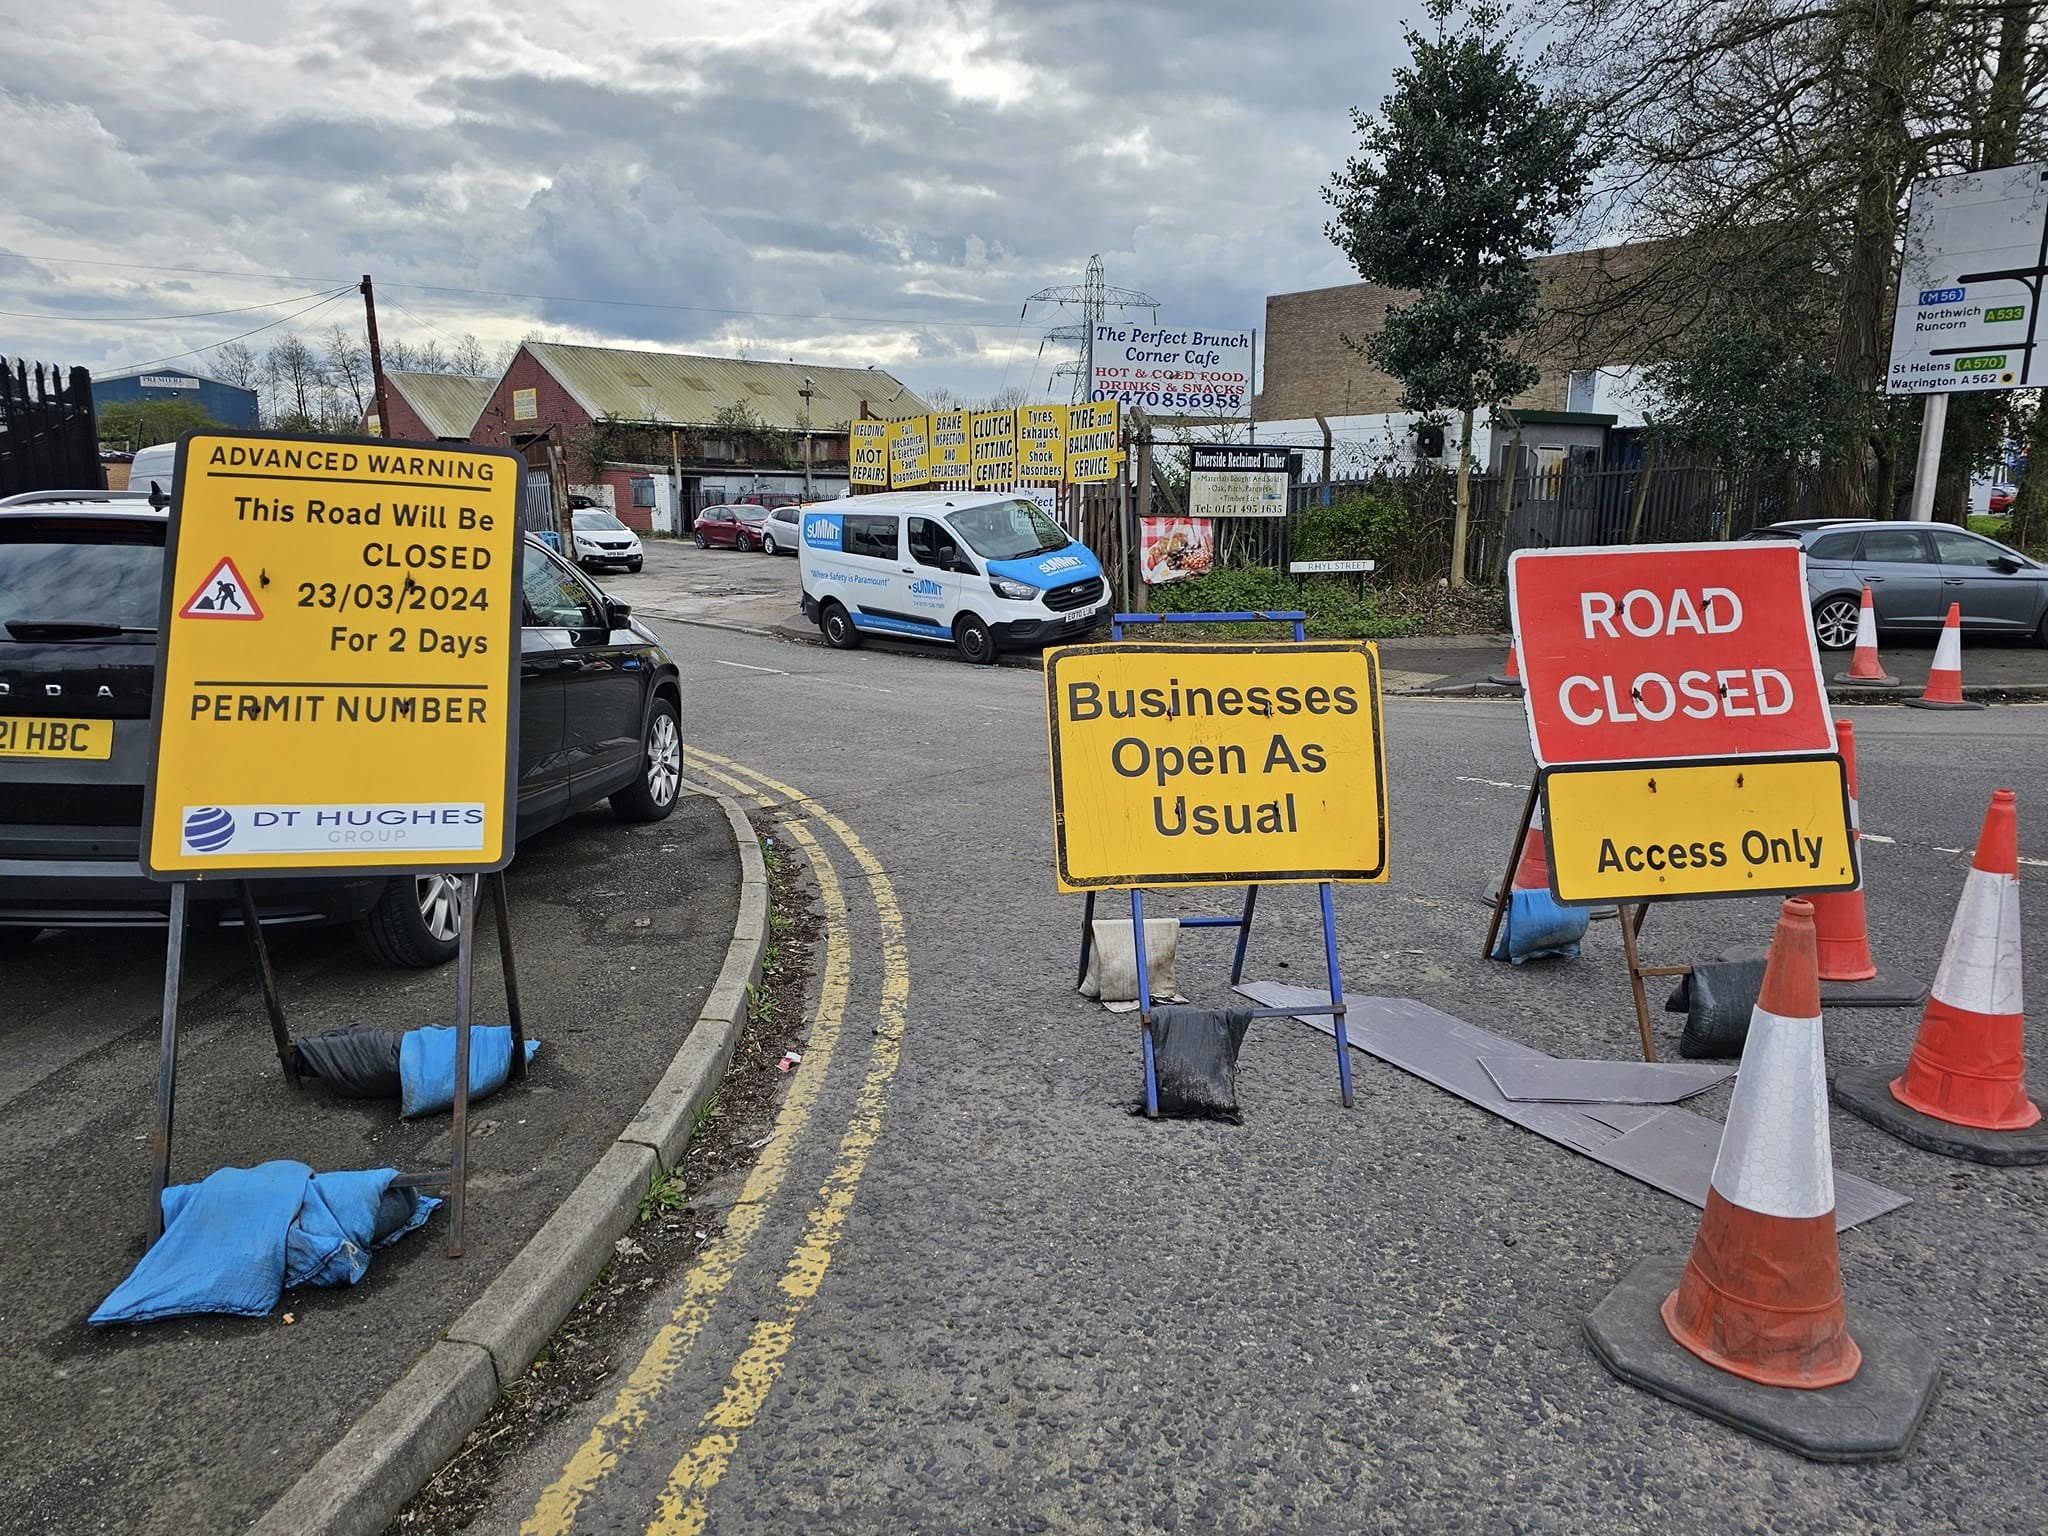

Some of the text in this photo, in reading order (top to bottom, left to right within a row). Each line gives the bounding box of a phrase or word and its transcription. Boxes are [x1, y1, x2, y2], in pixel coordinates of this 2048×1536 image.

[1917, 306, 1981, 320] Northwich
[1915, 321, 1967, 332] Runcorn
[1096, 326, 1249, 348] The Perfect Brunch
[1125, 347, 1220, 368] Corner Cafe
[1095, 367, 1130, 378] HOT
[1135, 368, 1147, 379] &
[1151, 370, 1195, 380] COLD
[1892, 364, 1906, 374] St
[1910, 362, 1951, 373] Helens
[1099, 380, 1245, 395] DRINKS & SNACKS
[1891, 376, 1957, 389] Warrington
[936, 415, 962, 431] BRAKE
[1028, 410, 1056, 425] Tyres,
[1069, 407, 1113, 431] TYRE and
[853, 424, 885, 437] WELDING
[901, 423, 913, 436] Full
[973, 415, 1012, 439] CLUTCH
[1021, 426, 1062, 440] Exhaust,
[891, 432, 925, 449] Mechanical
[933, 431, 966, 447] INSPECTION
[1035, 440, 1047, 449] and
[1069, 431, 1115, 454] BALANCING
[855, 448, 882, 464] MOT
[898, 444, 927, 460] Electrical
[943, 448, 956, 461] AND
[975, 439, 1013, 460] FITTING
[1028, 450, 1053, 463] Shock
[209, 446, 495, 481] ADVANCED WARNING
[901, 459, 917, 470] Fault
[1074, 456, 1110, 478] SERVICE.
[1194, 451, 1286, 469] Riverside Reclaimed Timber
[852, 466, 886, 481] REPAIRS
[892, 469, 928, 483] Diagnostics
[931, 463, 970, 478] REPLACEMENT
[976, 461, 1014, 482] CENTRE
[1020, 464, 1062, 476] Absorbers
[234, 496, 495, 532] This Road Will Be
[1195, 503, 1283, 513] Tel: 0151 495 1635
[806, 518, 840, 540] SUMMIT
[362, 542, 492, 571] CLOSED
[1038, 556, 1083, 573] SUMMIT
[1308, 561, 1367, 571] RHYL STREET
[829, 571, 848, 583] Safety
[848, 575, 854, 583] is
[911, 579, 943, 596] SUMMIT
[297, 581, 490, 614] 23/03/2024
[1580, 586, 1744, 640] ROAD
[329, 626, 489, 659] For 2 Days
[1068, 677, 1359, 722] Businesses
[1558, 668, 1795, 727] CLOSED
[190, 694, 488, 724] PERMIT NUMBER
[26, 720, 90, 752] HBC
[1111, 733, 1328, 787] Open As
[252, 808, 484, 828] DT HUGHES
[1152, 792, 1298, 837] Usual
[327, 829, 407, 844] GROUP
[1596, 828, 1823, 874] Access Only
